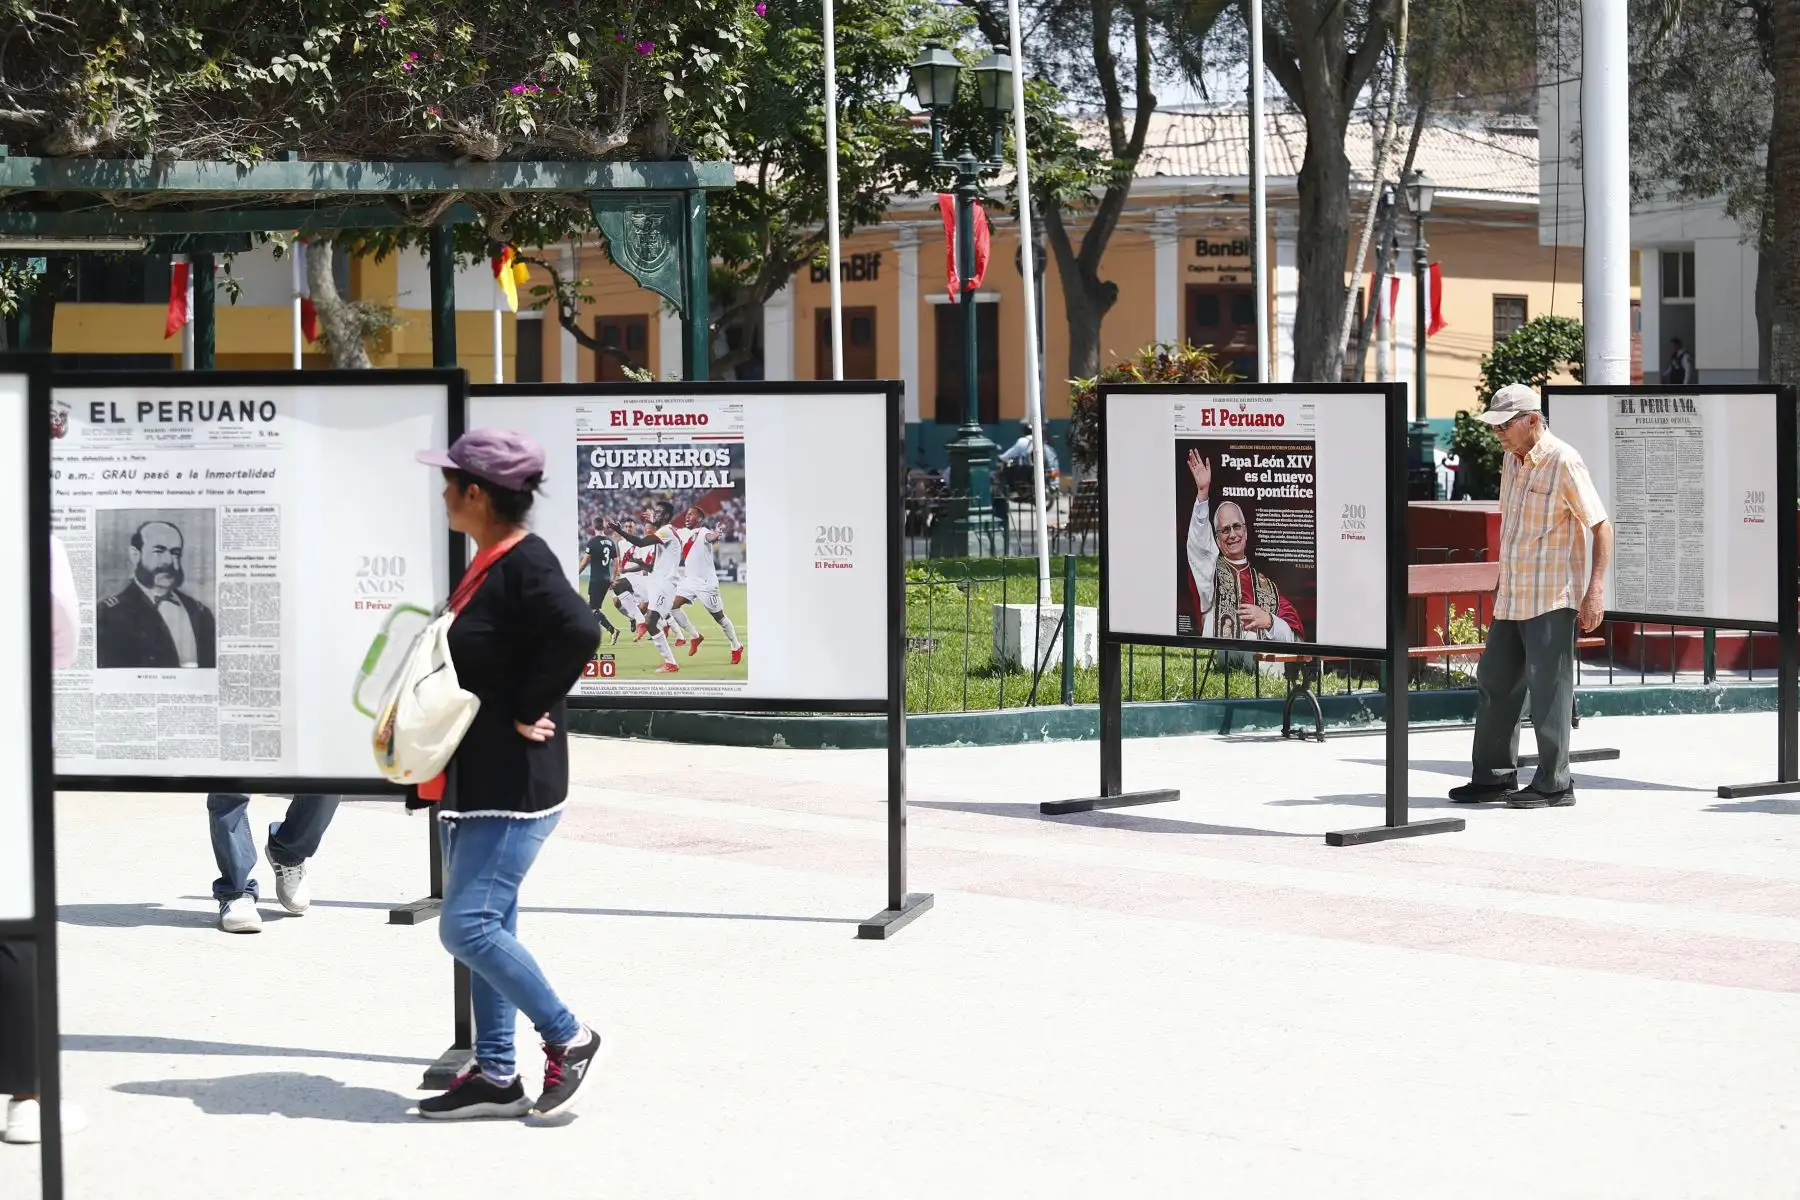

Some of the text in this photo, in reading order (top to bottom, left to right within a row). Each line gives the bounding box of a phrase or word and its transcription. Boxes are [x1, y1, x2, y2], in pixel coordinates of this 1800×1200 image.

[1196, 240, 1249, 257] BanBi
[810, 253, 882, 283] BnBif
[90, 400, 277, 423] EL PERUANO
[1621, 399, 1636, 414] EL
[610, 410, 628, 426] El
[632, 410, 709, 426] Peruano
[1201, 408, 1216, 427] El
[1220, 409, 1285, 427] Peruano
[590, 447, 731, 468] GUERREROS
[1221, 454, 1313, 470] Papa León XIV
[68, 472, 95, 480] a.m.:
[102, 469, 137, 480] GRAU
[143, 470, 169, 481] pasó
[176, 471, 183, 479] a
[189, 468, 199, 479] la
[205, 468, 276, 479] Inmortalidad
[587, 469, 735, 489] AL MUNDIAL
[1244, 469, 1313, 484] es el nuevo
[1222, 484, 1313, 500] sumo pontífice
[1341, 503, 1366, 518] 200
[815, 525, 854, 543] 200
[601, 547, 610, 566] 3
[354, 555, 406, 577] 200
[815, 561, 853, 569] El Peruano
[354, 600, 363, 610] El
[586, 662, 595, 676] 2
[602, 662, 613, 676] 0
